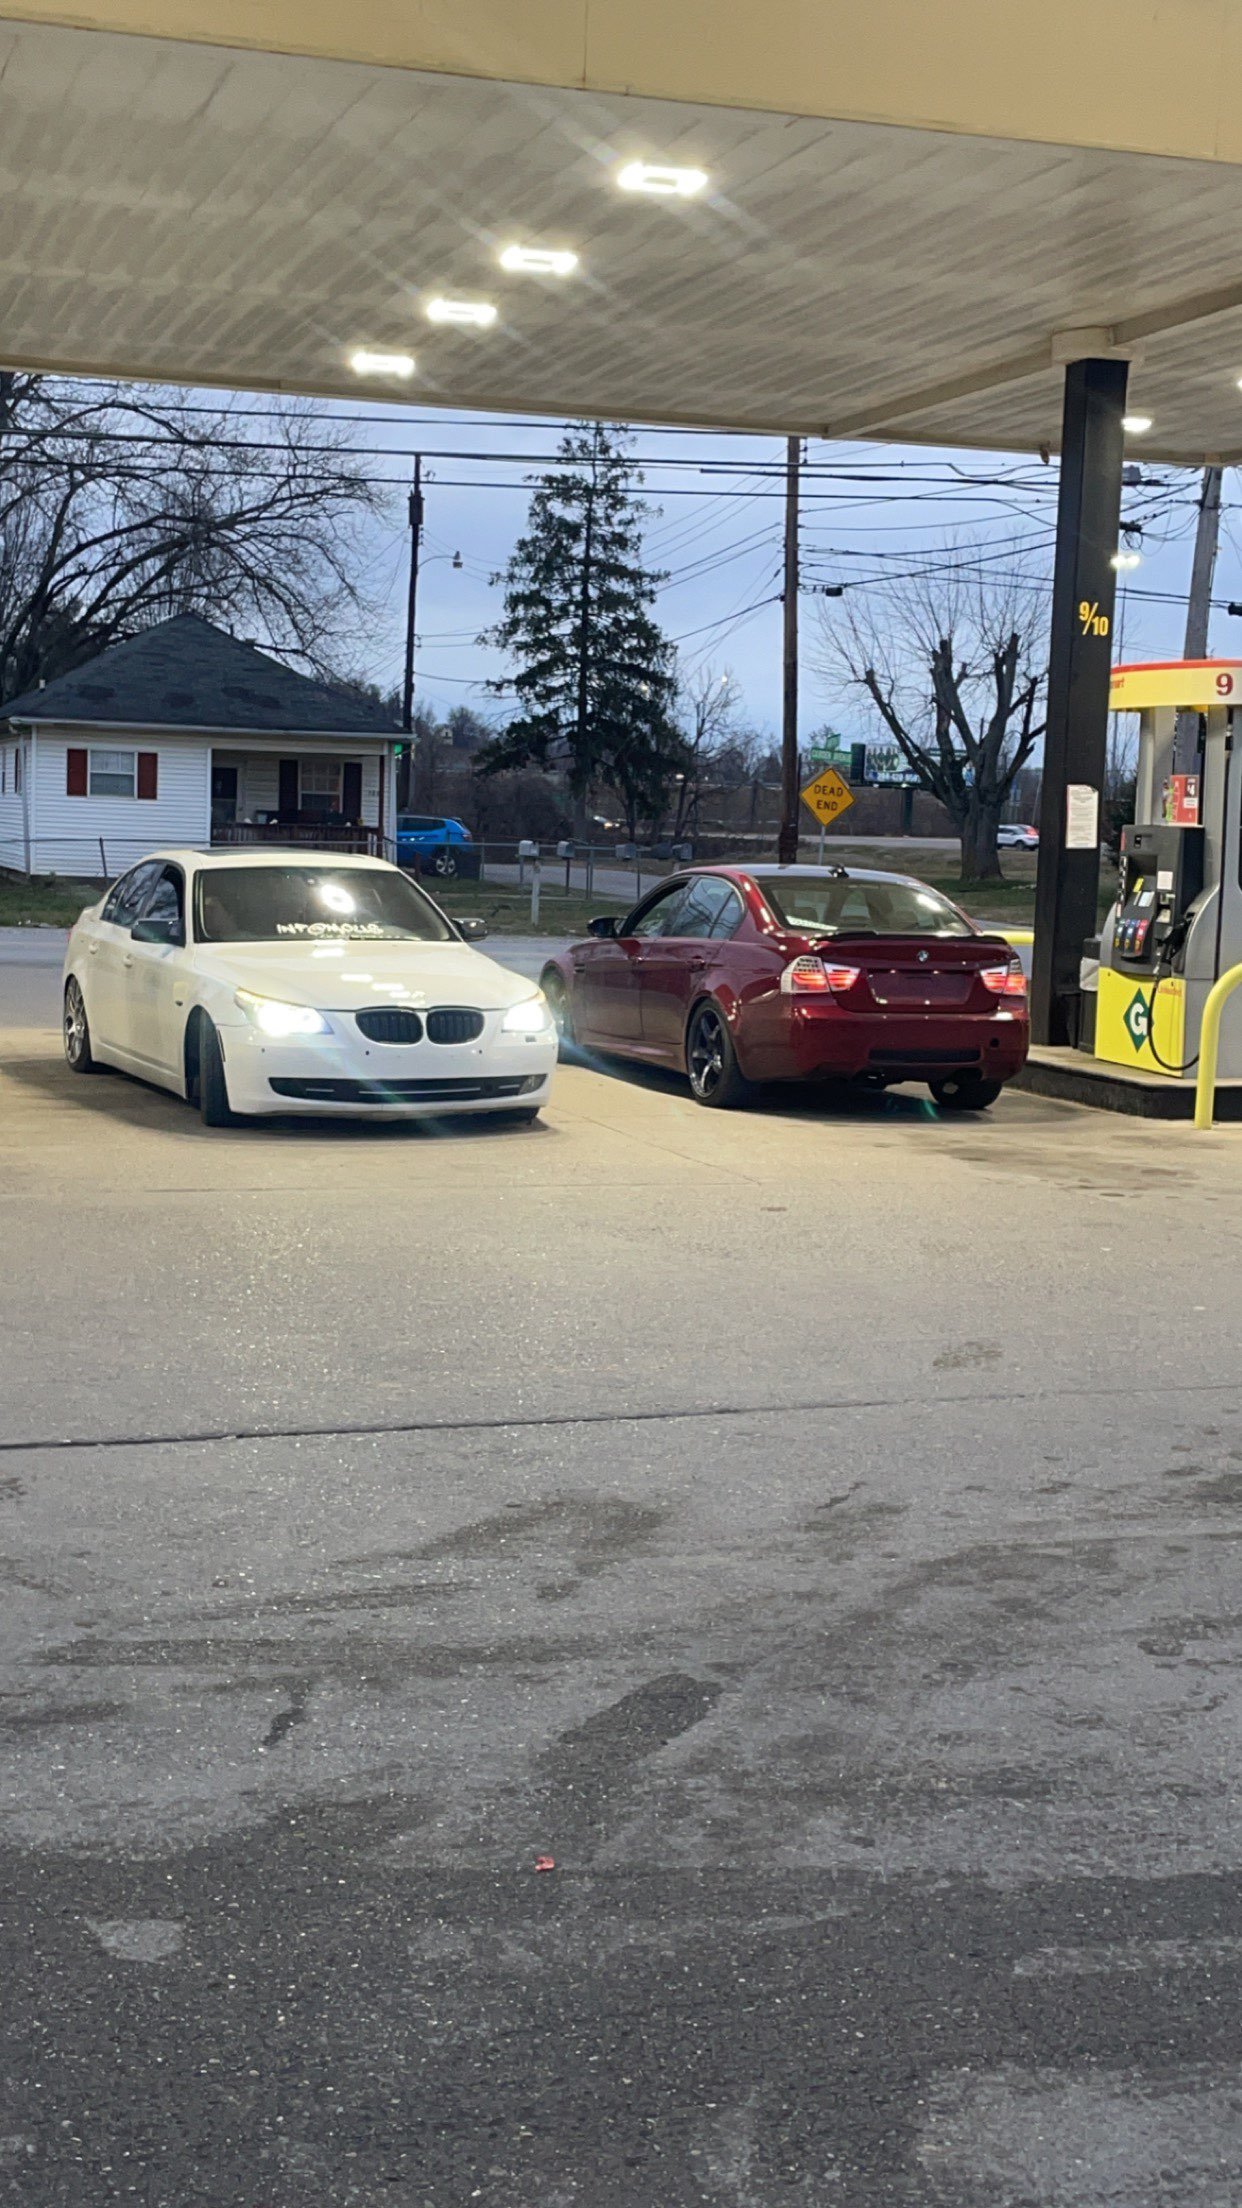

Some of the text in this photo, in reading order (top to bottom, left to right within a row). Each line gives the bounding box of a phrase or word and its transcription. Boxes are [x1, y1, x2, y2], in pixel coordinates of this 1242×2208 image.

[1079, 601, 1109, 636] 9/10
[1215, 672, 1234, 696] 9
[813, 784, 844, 796] DEAD
[816, 800, 838, 811] END
[1129, 1002, 1148, 1036] G
